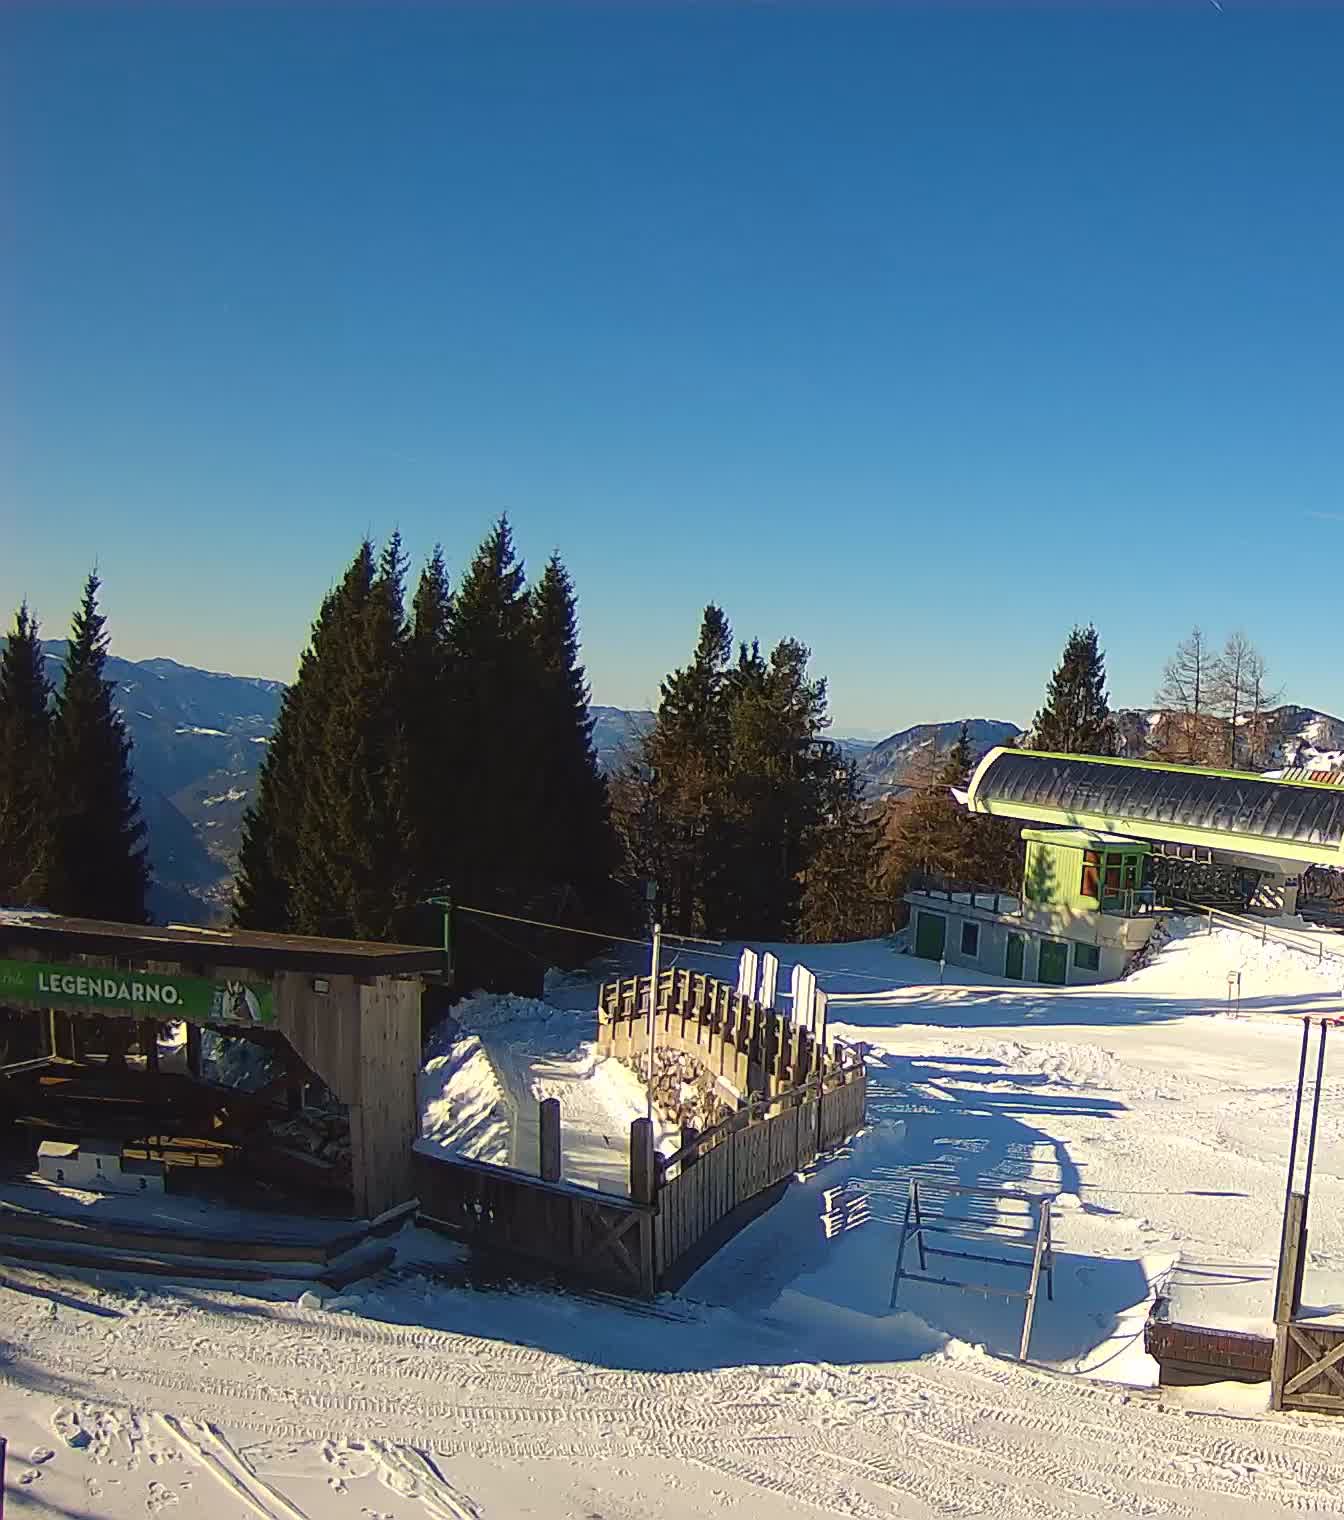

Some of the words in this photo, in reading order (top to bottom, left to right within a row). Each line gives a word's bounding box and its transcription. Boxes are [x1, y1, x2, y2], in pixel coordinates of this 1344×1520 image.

[37, 971, 184, 1006] LEGENDARNO.
[96, 1158, 103, 1169] 1
[57, 1169, 65, 1181] 2
[139, 1178, 147, 1189] 3
